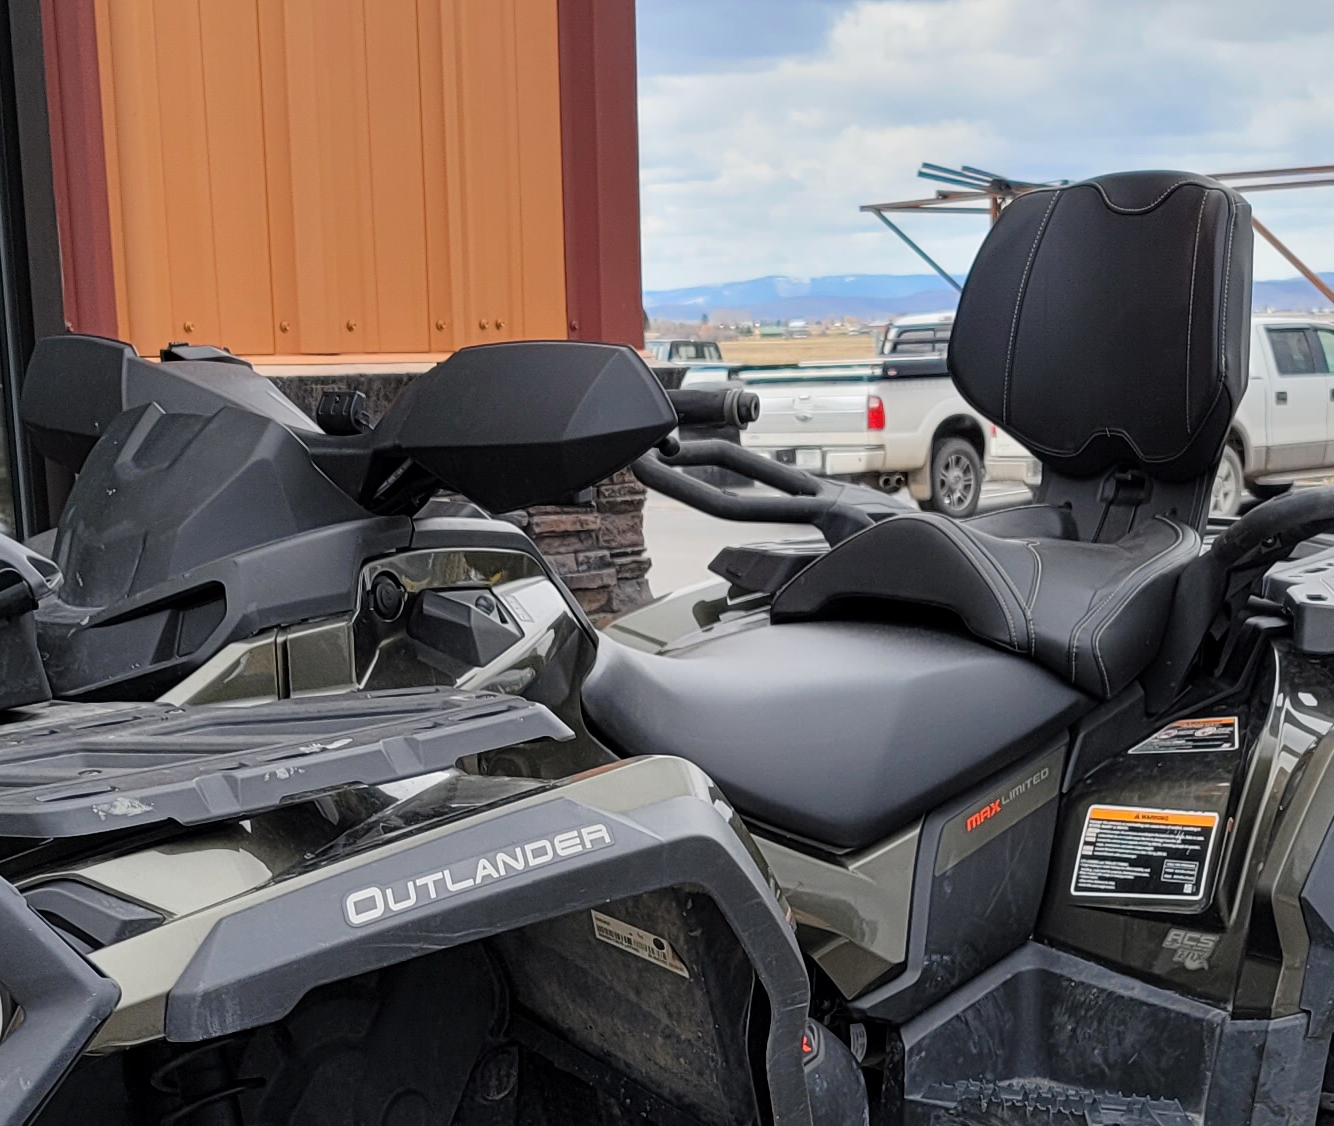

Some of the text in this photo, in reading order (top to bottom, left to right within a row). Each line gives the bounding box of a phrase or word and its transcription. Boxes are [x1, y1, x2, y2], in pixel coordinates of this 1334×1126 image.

[966, 767, 1049, 832] MAX LIMITED
[346, 823, 611, 925] OUTLANDER
[1167, 930, 1217, 948] ACS
